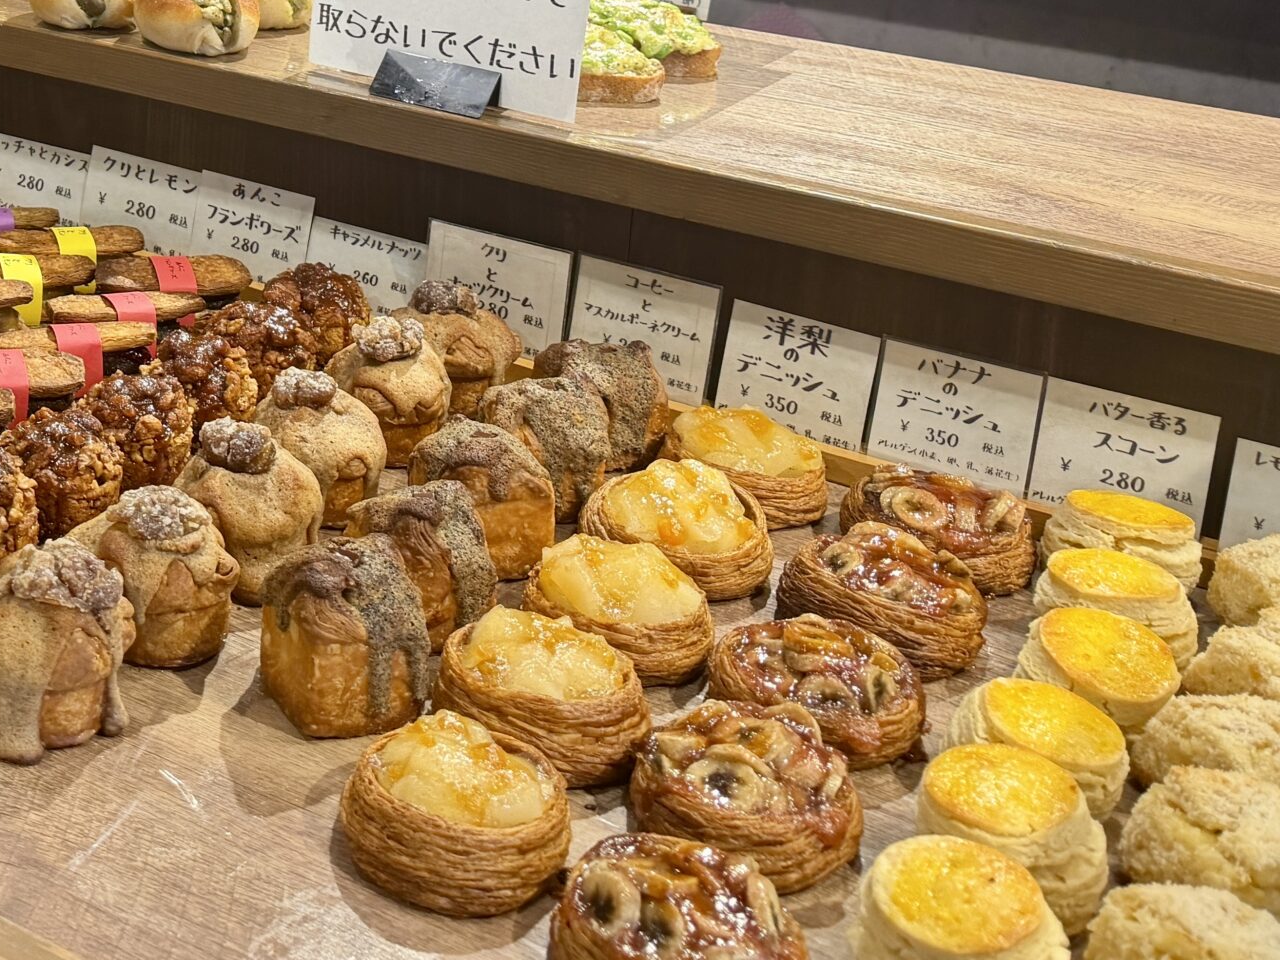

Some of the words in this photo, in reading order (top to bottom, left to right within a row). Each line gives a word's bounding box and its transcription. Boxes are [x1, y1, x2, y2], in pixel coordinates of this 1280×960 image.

[317, 2, 575, 78] 取らないでください
[17, 174, 44, 191] 280
[55, 185, 72, 199] 税込
[104, 156, 198, 194] クリとレモン
[99, 192, 107, 205] ¥
[124, 200, 156, 220] 280
[169, 213, 188, 228] 税込
[232, 183, 280, 207] あんこ
[208, 204, 301, 244] フランボワーズ
[207, 228, 214, 240] ¥
[231, 236, 260, 254] 280
[271, 248, 289, 262] 税込
[330, 225, 421, 260] キャラメルナッツ
[481, 243, 507, 263] クリ
[353, 270, 379, 286] 260
[390, 281, 407, 294] 税込
[486, 267, 497, 282] と
[625, 274, 674, 295] コーヒー
[523, 314, 544, 329] 税込
[641, 299, 652, 312] と
[763, 316, 832, 357] 洋梨
[660, 351, 681, 365] 税込
[783, 348, 799, 362] の
[918, 359, 992, 384] バナナ
[737, 353, 840, 402] デニッシュ
[942, 382, 958, 396] の
[741, 384, 750, 397] ¥
[765, 393, 798, 415] 350
[821, 410, 843, 427] 税込
[897, 389, 1001, 433] デニッシュ
[1089, 402, 1187, 436] バター香る
[901, 419, 910, 432] ¥
[925, 427, 959, 448] 350
[982, 442, 1005, 457] 税込
[1093, 431, 1180, 464] スコーン
[1060, 457, 1072, 471] ¥
[1099, 469, 1145, 493] 280
[1165, 488, 1193, 505] 税込
[1254, 516, 1266, 531] ¥
